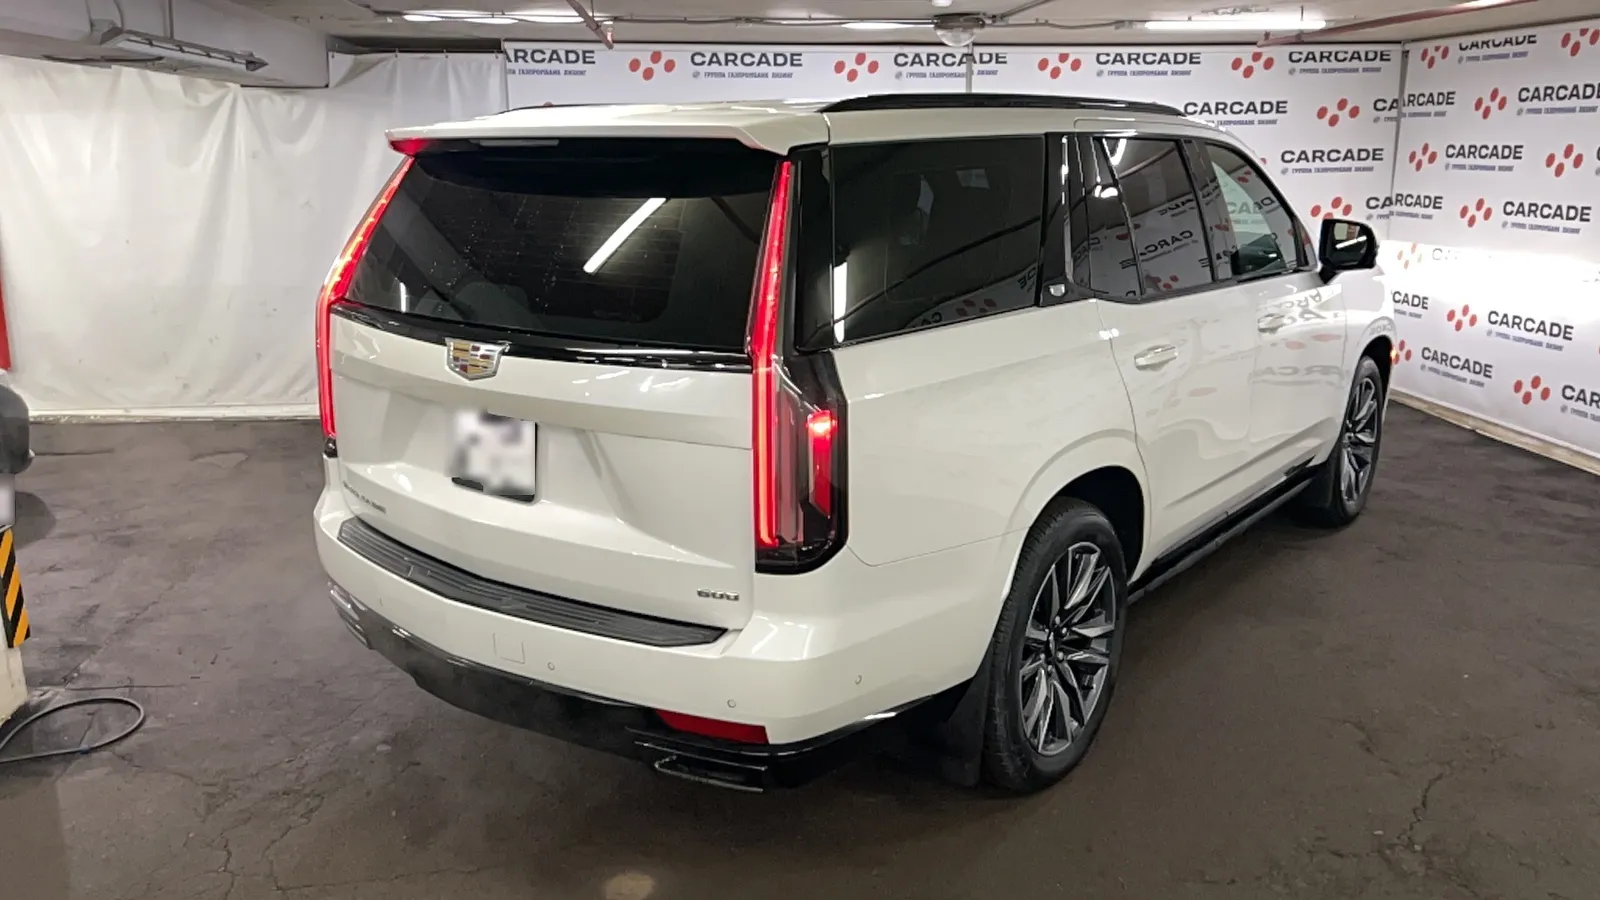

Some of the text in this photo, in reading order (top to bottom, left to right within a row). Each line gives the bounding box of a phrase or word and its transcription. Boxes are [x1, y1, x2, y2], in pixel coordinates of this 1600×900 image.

[690, 51, 803, 67] CARCADE
[893, 52, 1008, 67] CARCADE
[1095, 52, 1202, 65] CARCADE
[1288, 50, 1392, 63] CARCADE
[1183, 100, 1288, 115] CARCADE
[1373, 91, 1456, 112] CARCADE
[1280, 148, 1384, 163] CARCADE
[1445, 143, 1524, 160] CARCADE
[1365, 193, 1443, 210] CARCADE
[1503, 200, 1592, 222] CARCADE
[1391, 290, 1429, 310] CADE
[1487, 310, 1574, 341] CARCADE
[1421, 346, 1493, 379] CARCADE
